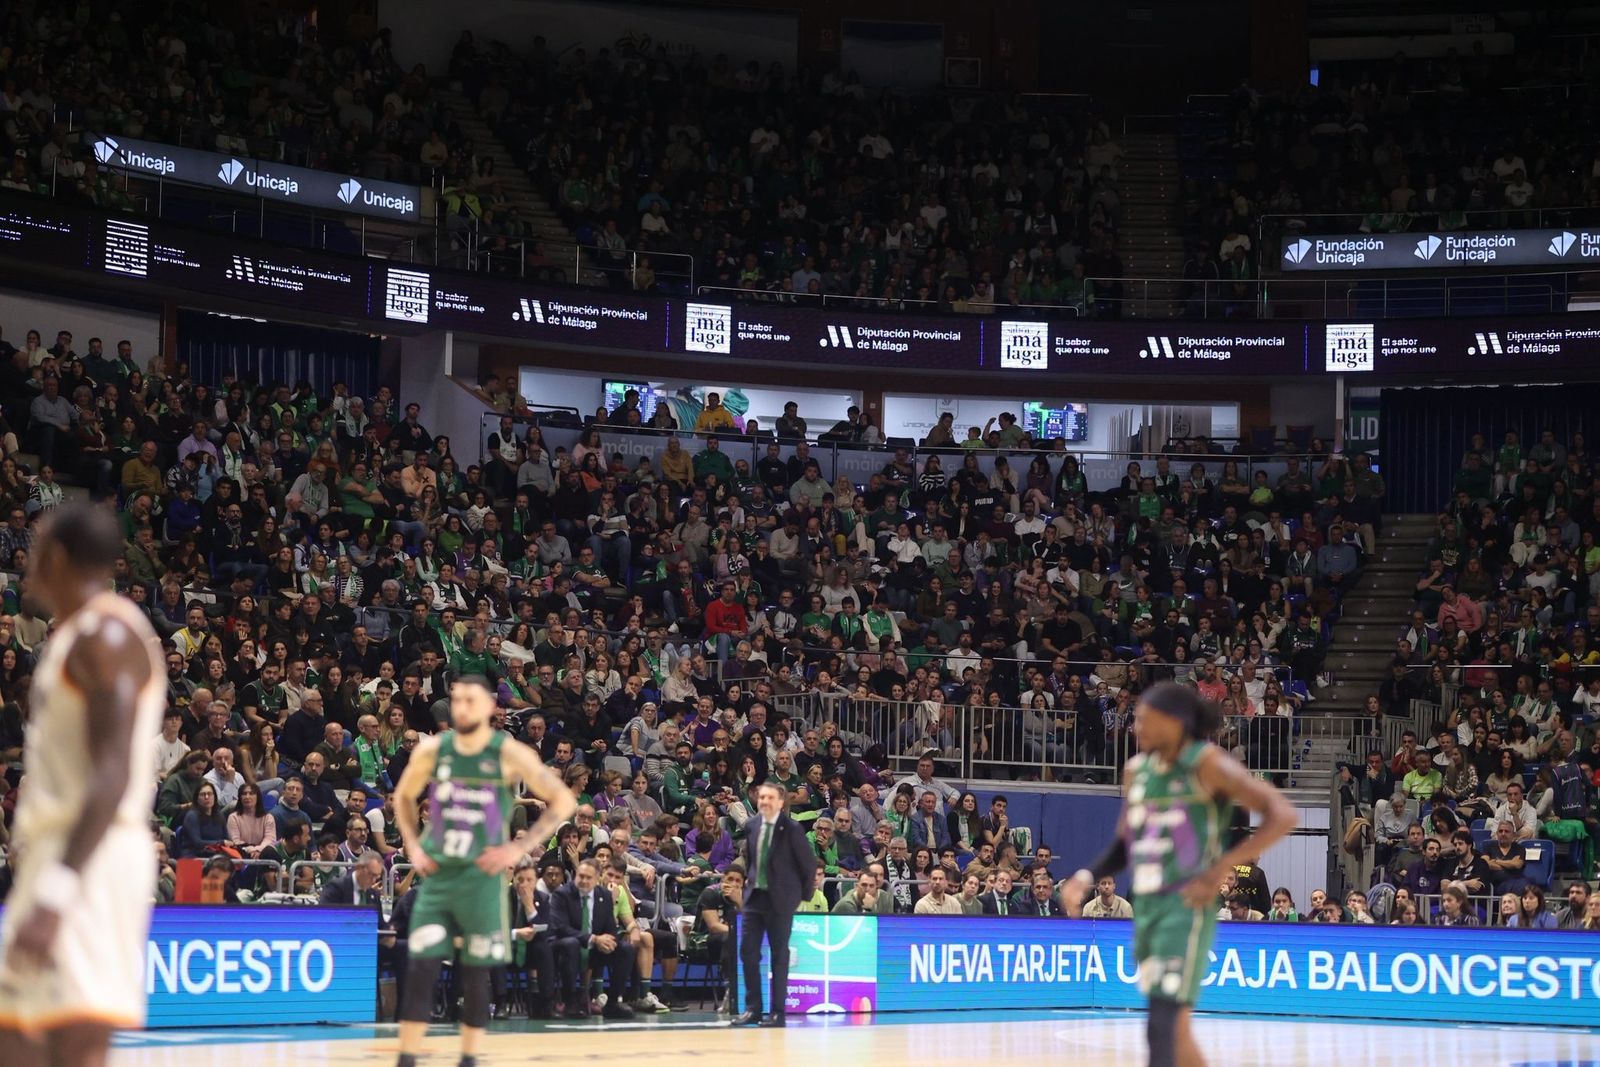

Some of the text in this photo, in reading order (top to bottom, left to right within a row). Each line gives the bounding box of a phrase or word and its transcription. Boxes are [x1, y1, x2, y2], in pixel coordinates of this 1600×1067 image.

[120, 148, 175, 174] Unicaja
[245, 170, 298, 195] Unicaja
[363, 189, 414, 212] Unicaja
[1315, 238, 1384, 252] Fundación
[1446, 235, 1516, 249] Fundación
[1315, 249, 1365, 266] Unicaja
[1446, 247, 1496, 263] Unicaja
[435, 300, 451, 310] que
[548, 301, 648, 321] Diputación Provincial
[547, 314, 597, 330] de Málaga
[738, 322, 773, 332] El sabor
[737, 331, 790, 341] que nos une
[857, 326, 961, 342] Diputación Provincial
[1507, 329, 1563, 343] Diputación
[857, 339, 909, 353] de Málaga
[1055, 337, 1091, 347] El sabor
[1178, 336, 1285, 349] Diputación Provincial
[1381, 338, 1418, 346] El sabor
[1506, 342, 1561, 355] de Málaga
[1055, 347, 1072, 356] que
[1092, 347, 1109, 355] une
[1178, 349, 1231, 361] de Málaga
[1381, 346, 1399, 356] que
[1419, 345, 1437, 354] une
[1345, 416, 1379, 441] LID
[910, 943, 994, 984] NUEVA
[998, 943, 1107, 983] TARJETA
[1116, 945, 1298, 990] UCAJA
